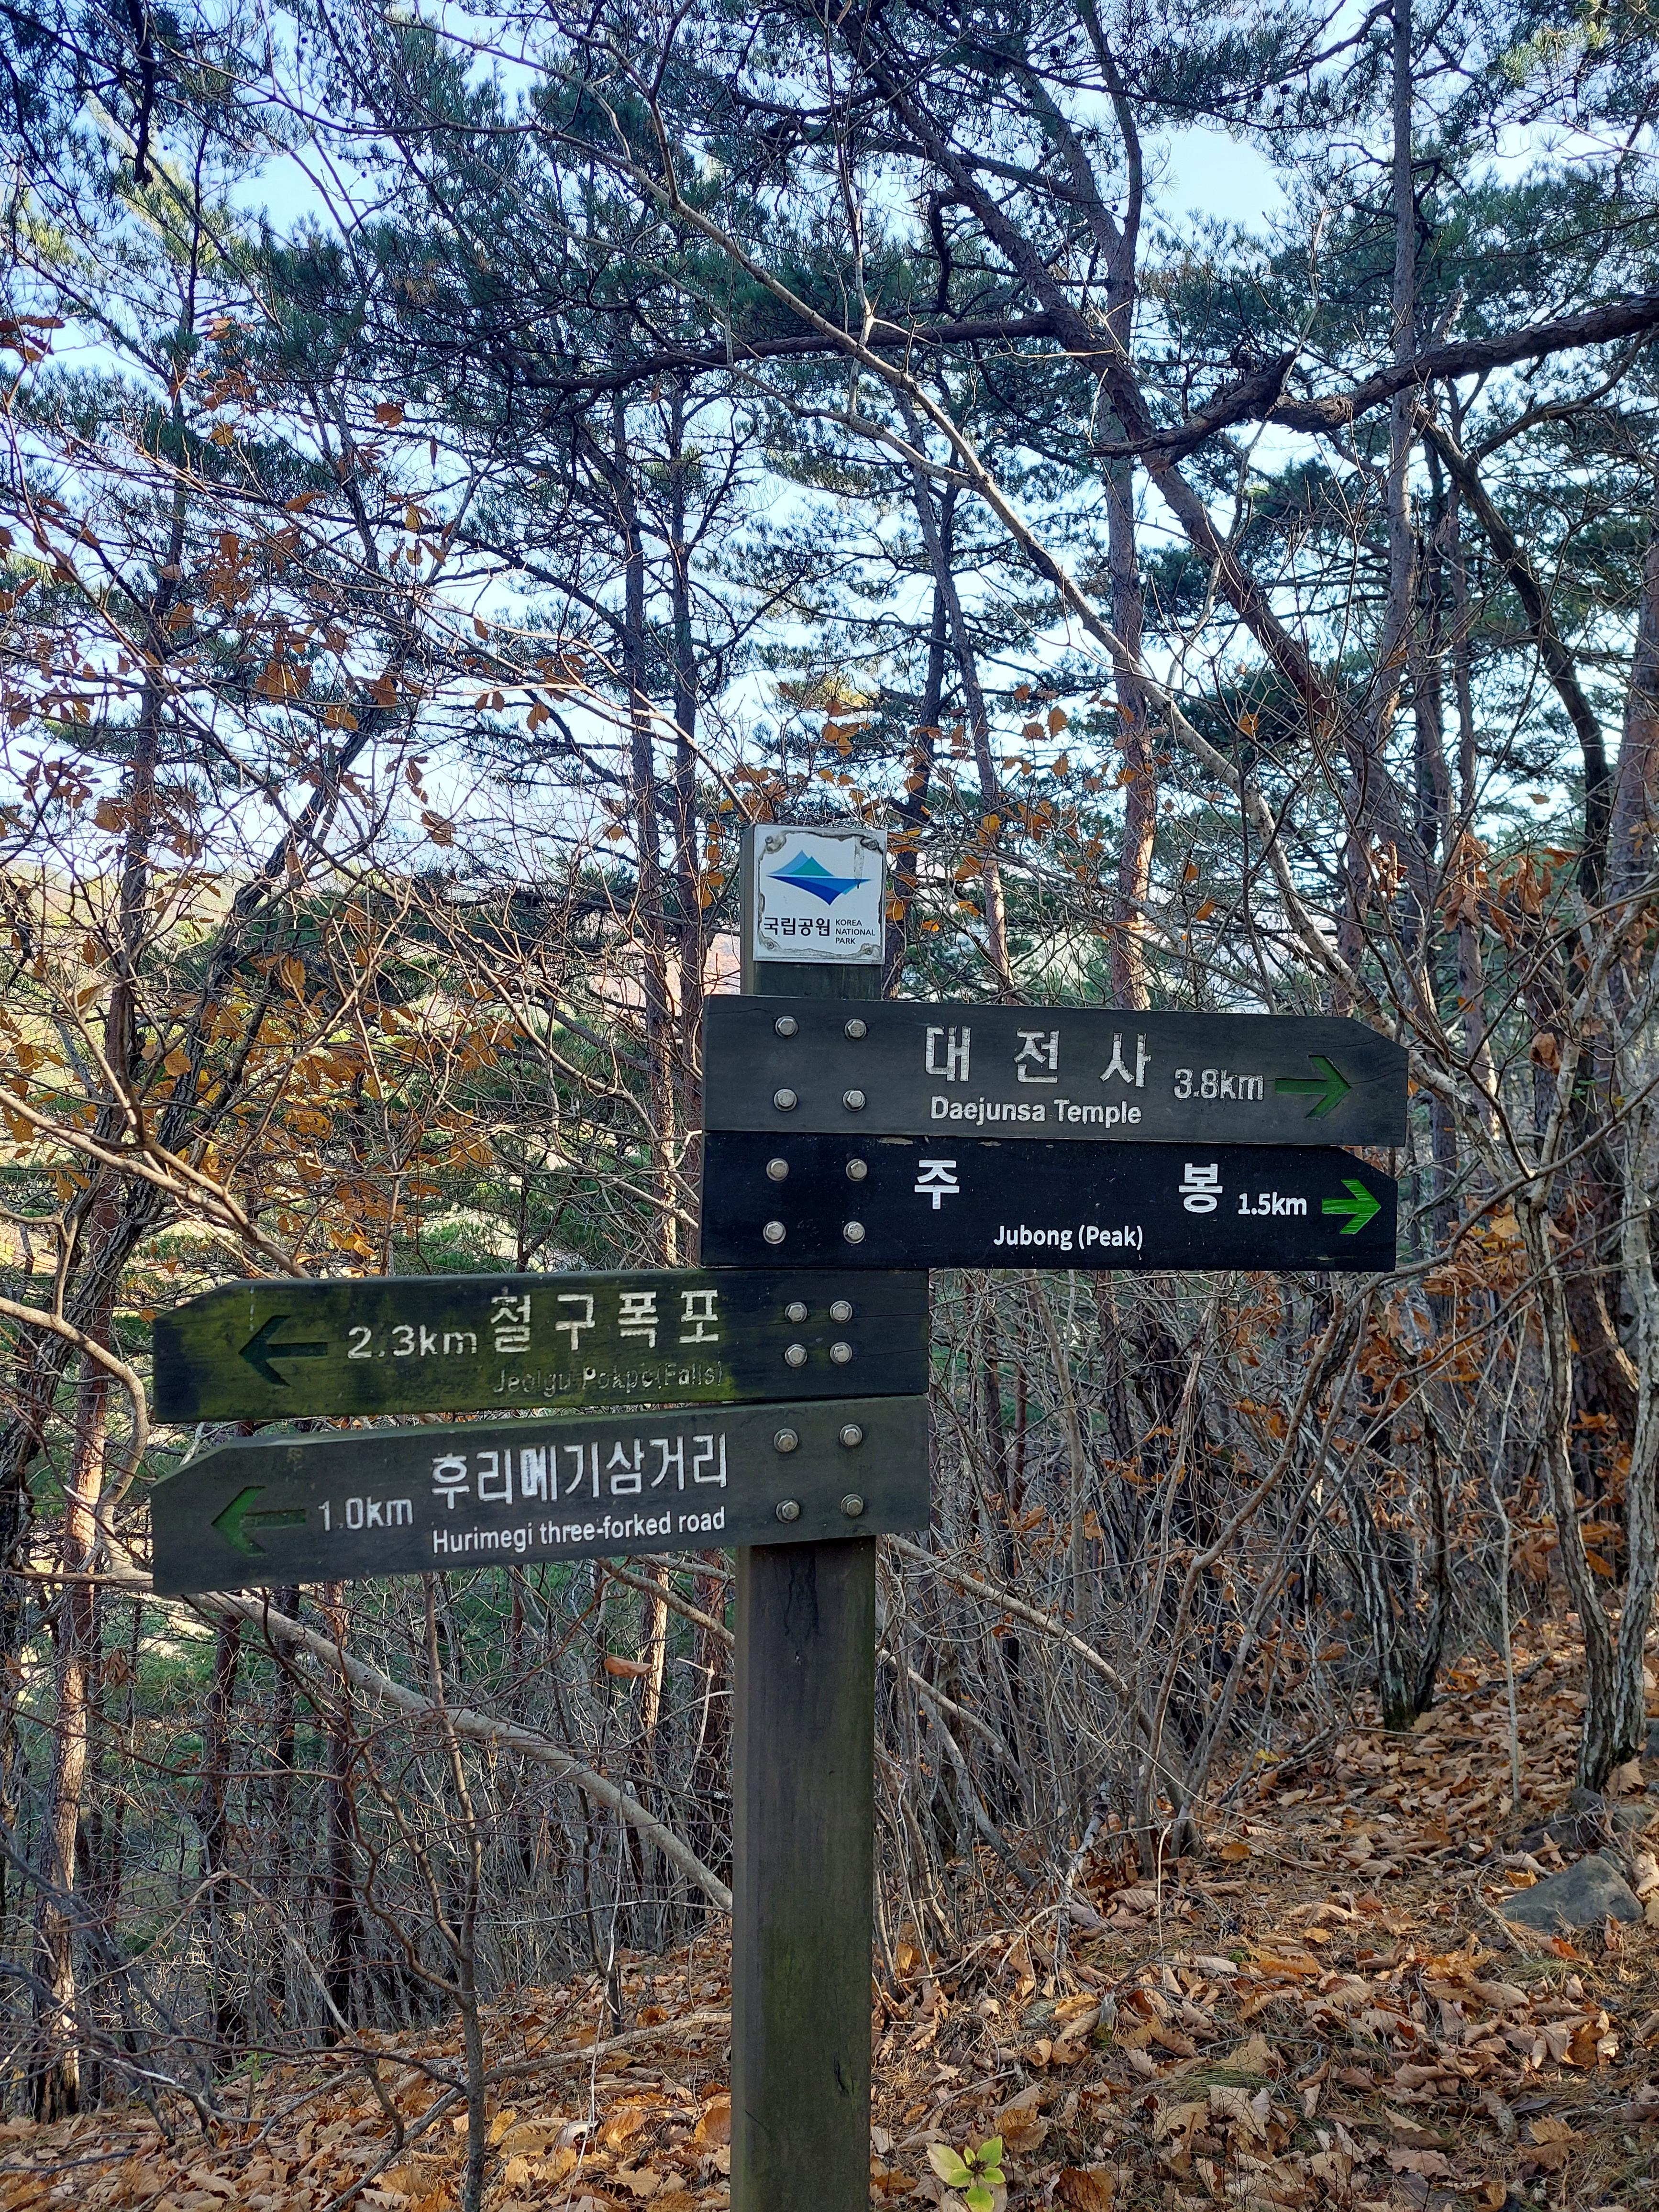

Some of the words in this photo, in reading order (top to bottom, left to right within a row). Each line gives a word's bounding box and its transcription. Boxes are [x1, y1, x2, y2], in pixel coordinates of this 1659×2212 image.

[764, 918, 830, 936] 국립공원
[1173, 1068, 1264, 1101] 3.8km
[930, 1096, 1046, 1127] Daejunsa
[1052, 1099, 1142, 1129] Temple
[1238, 1192, 1307, 1216] 1.5km
[993, 1226, 1073, 1251] Jubong
[1078, 1226, 1143, 1250] (Peak)
[347, 1324, 477, 1359] 2.3km
[318, 1496, 413, 1531] 1.0km
[431, 1432, 727, 1509] 후리메기삼거리
[432, 1522, 532, 1553] Hurimegi
[540, 1515, 671, 1544] three-forked
[677, 1506, 725, 1531] road
